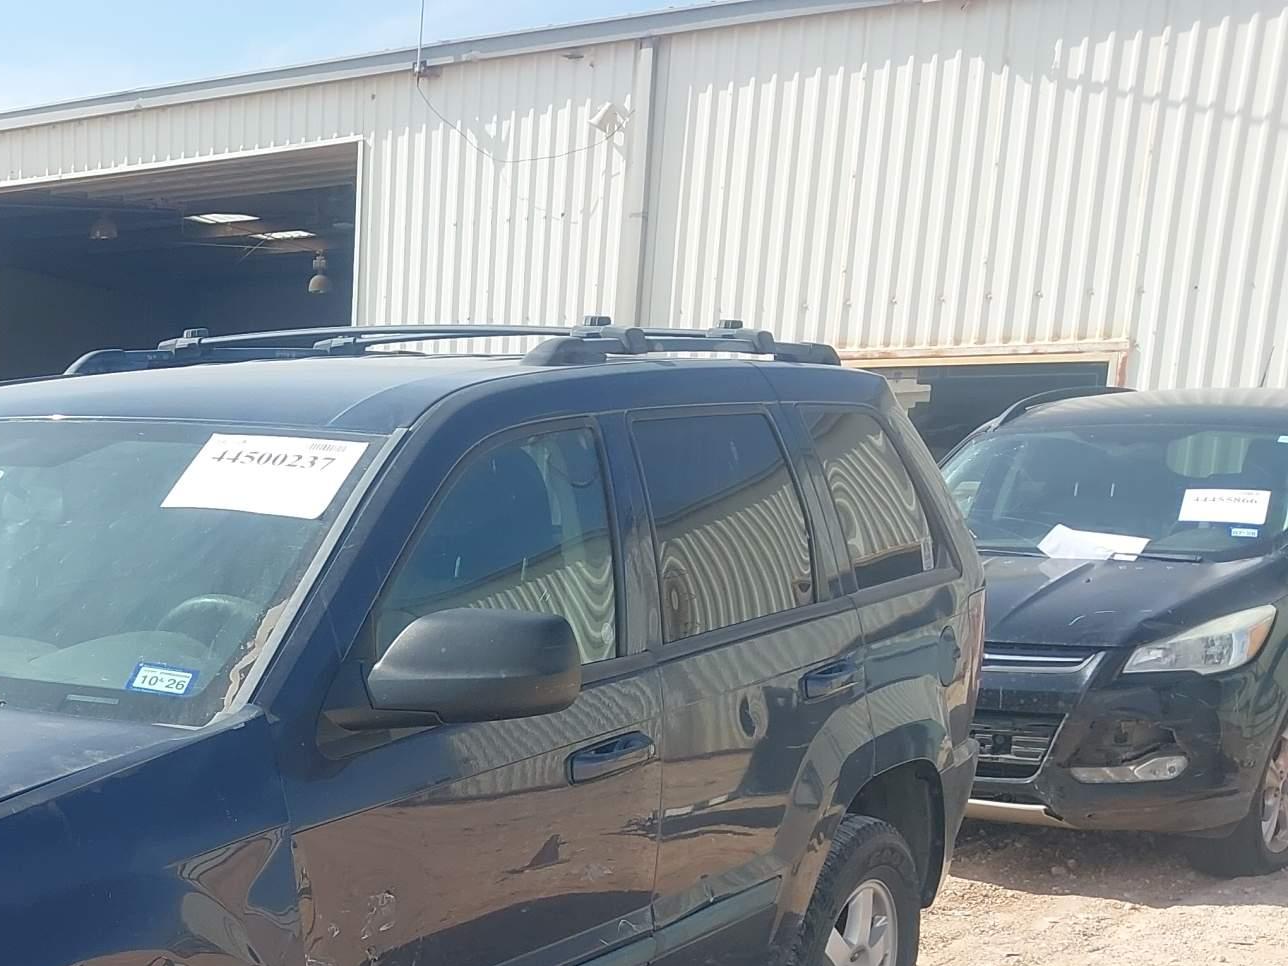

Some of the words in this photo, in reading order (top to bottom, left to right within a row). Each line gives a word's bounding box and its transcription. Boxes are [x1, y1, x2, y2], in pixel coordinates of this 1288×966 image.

[211, 449, 337, 472] 44500237
[140, 674, 159, 687] 10
[164, 678, 187, 691] 26
